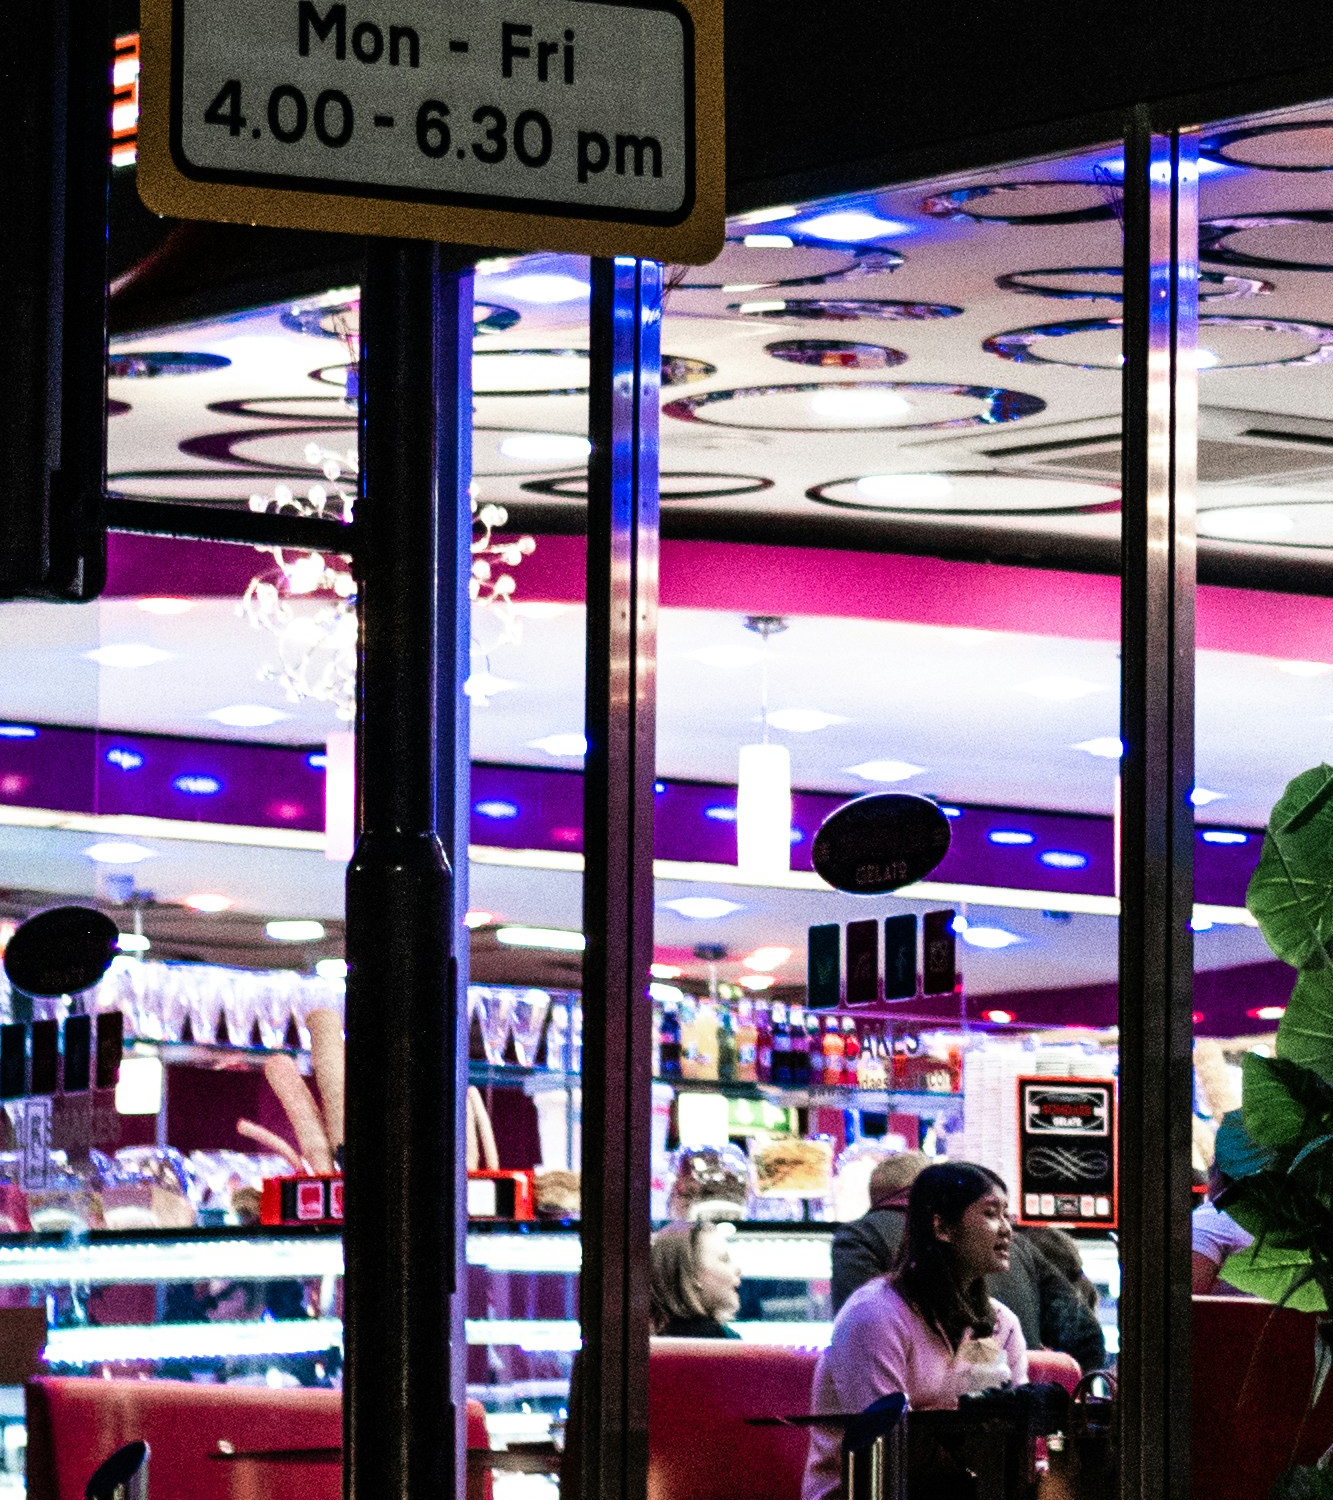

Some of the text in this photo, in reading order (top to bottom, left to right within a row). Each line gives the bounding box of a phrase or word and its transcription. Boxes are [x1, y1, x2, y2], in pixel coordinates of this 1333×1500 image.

[298, 1, 420, 68] Mon
[500, 22, 576, 85] Fri
[204, 80, 354, 148] 4.00
[416, 103, 553, 168] 6.30
[577, 126, 664, 184] pm
